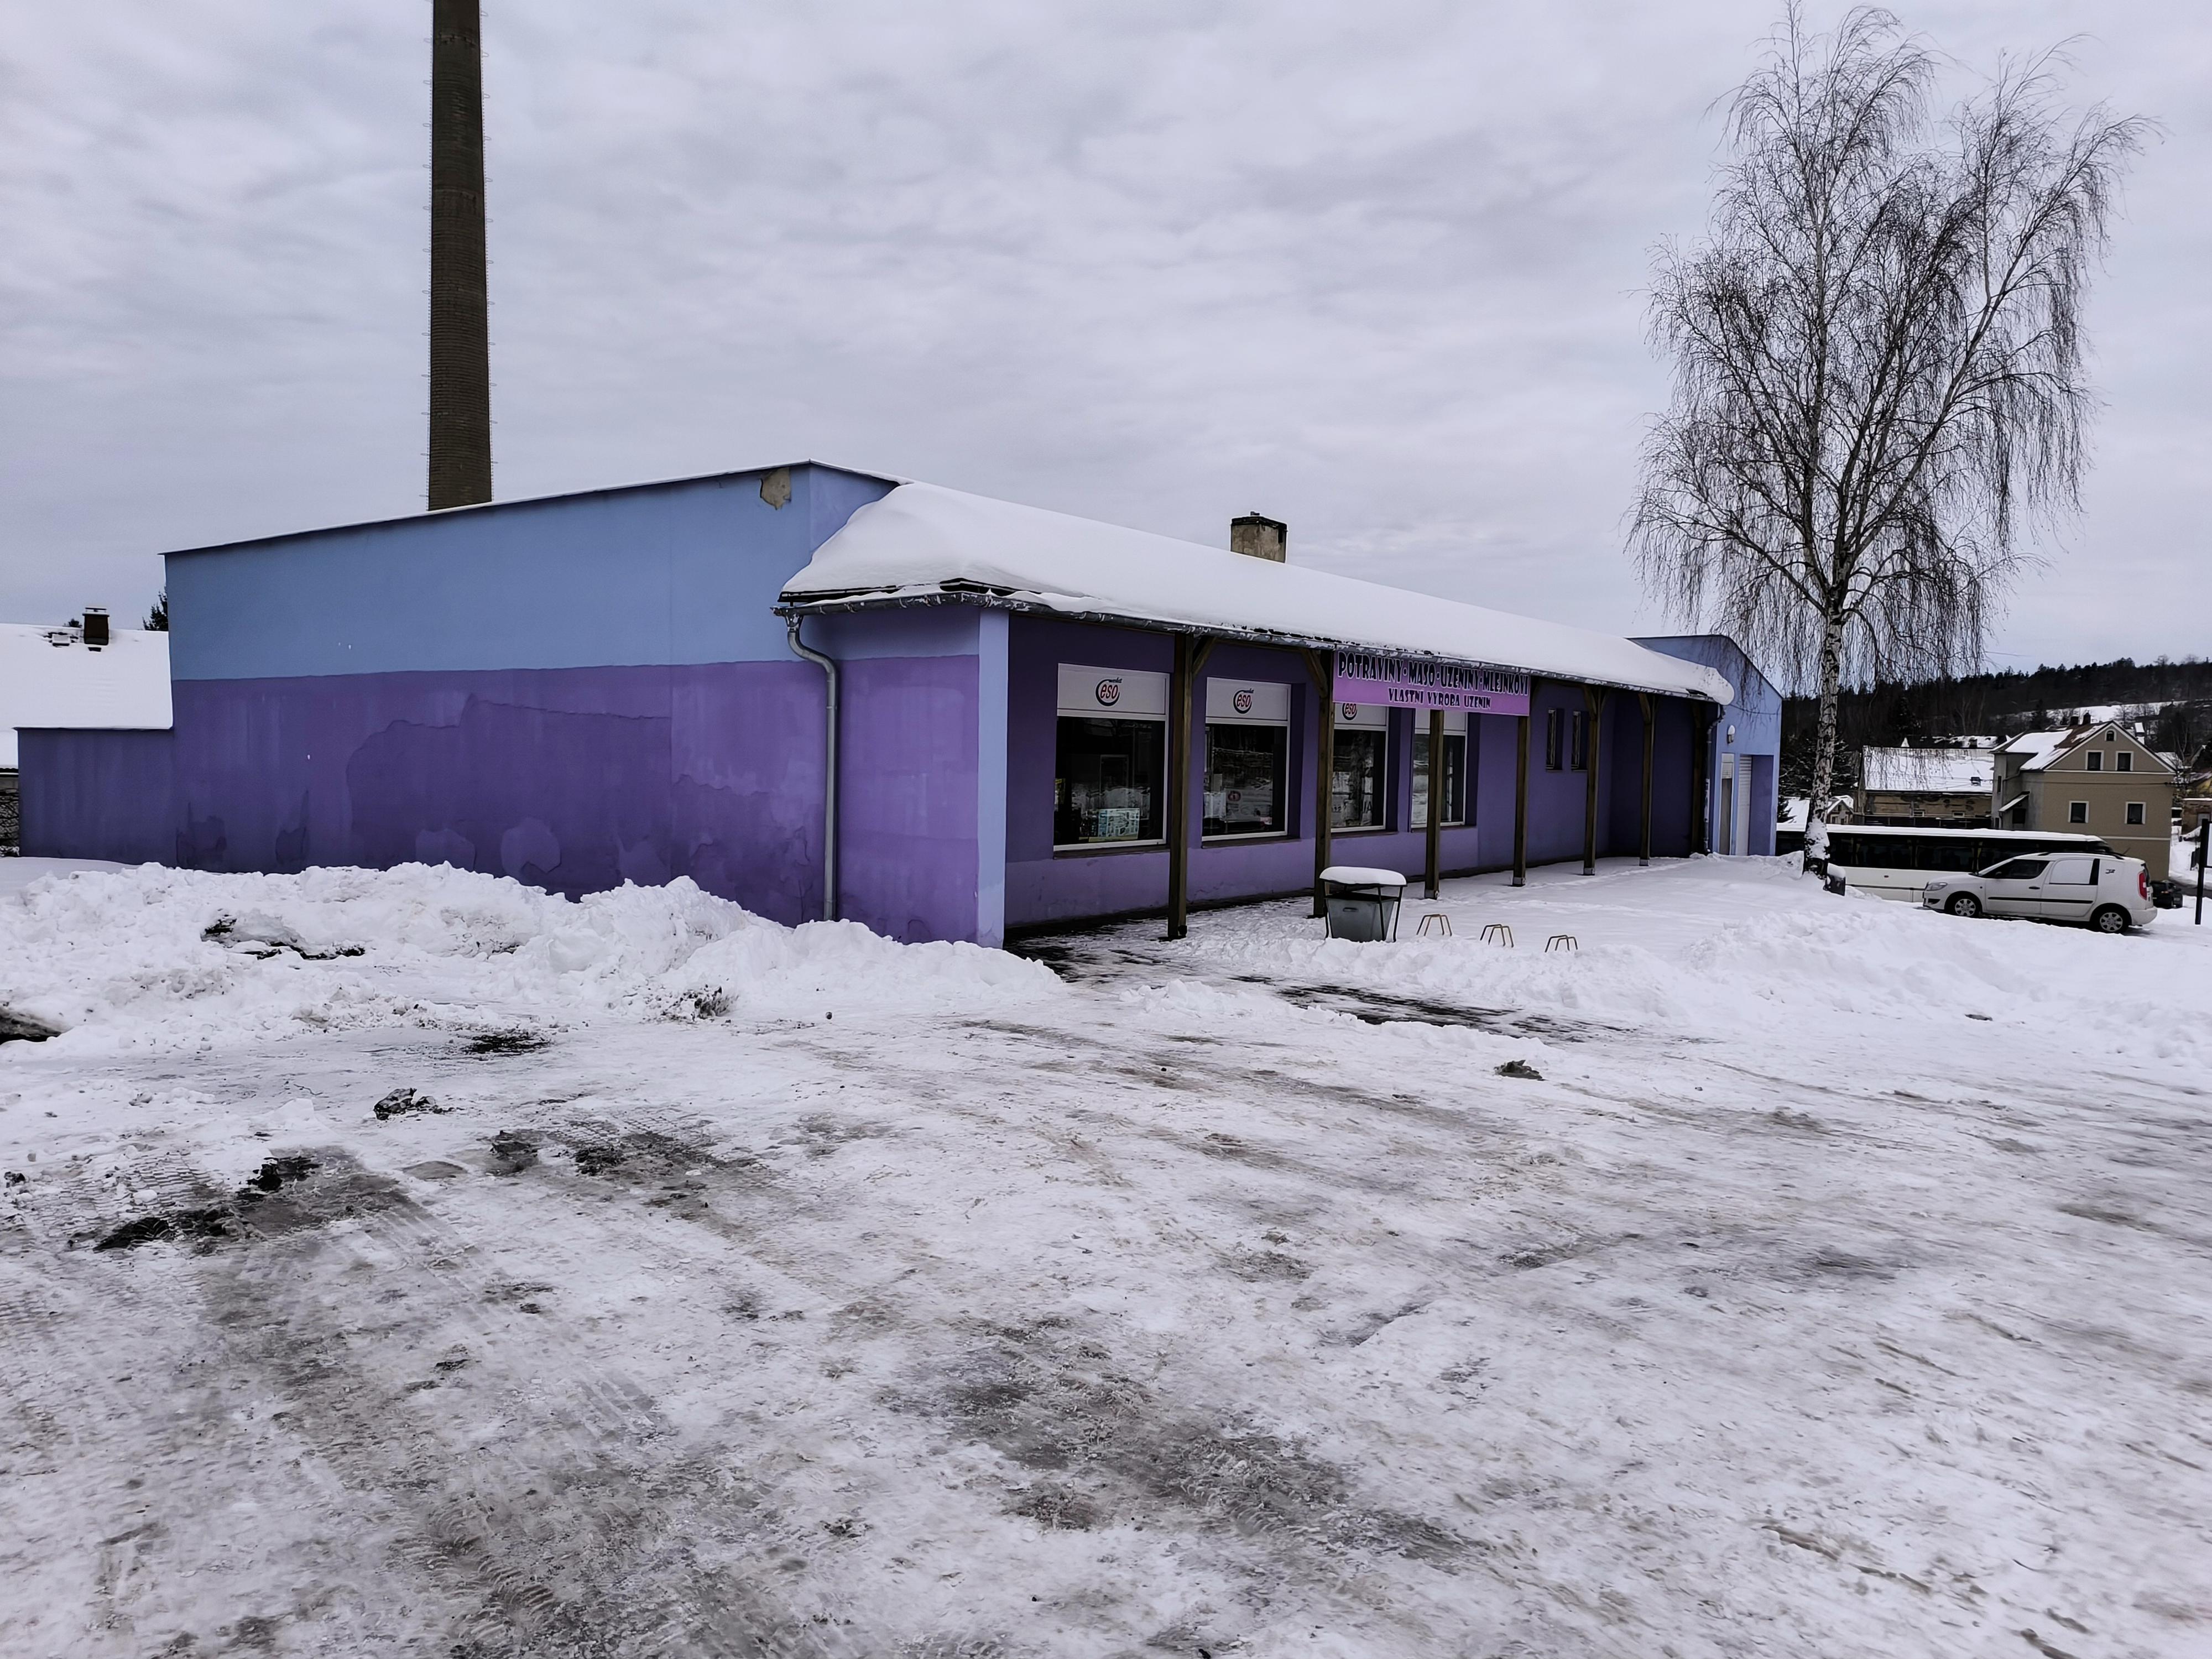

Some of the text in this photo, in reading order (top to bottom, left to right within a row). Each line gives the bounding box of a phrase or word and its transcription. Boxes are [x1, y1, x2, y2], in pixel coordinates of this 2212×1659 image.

[1338, 651, 1528, 696] POTRAVINY MASO UZENINY MLEJNKOVI
[1100, 684, 1118, 700] eso
[1237, 694, 1251, 708] eso
[1464, 695, 1491, 709] UZENIN
